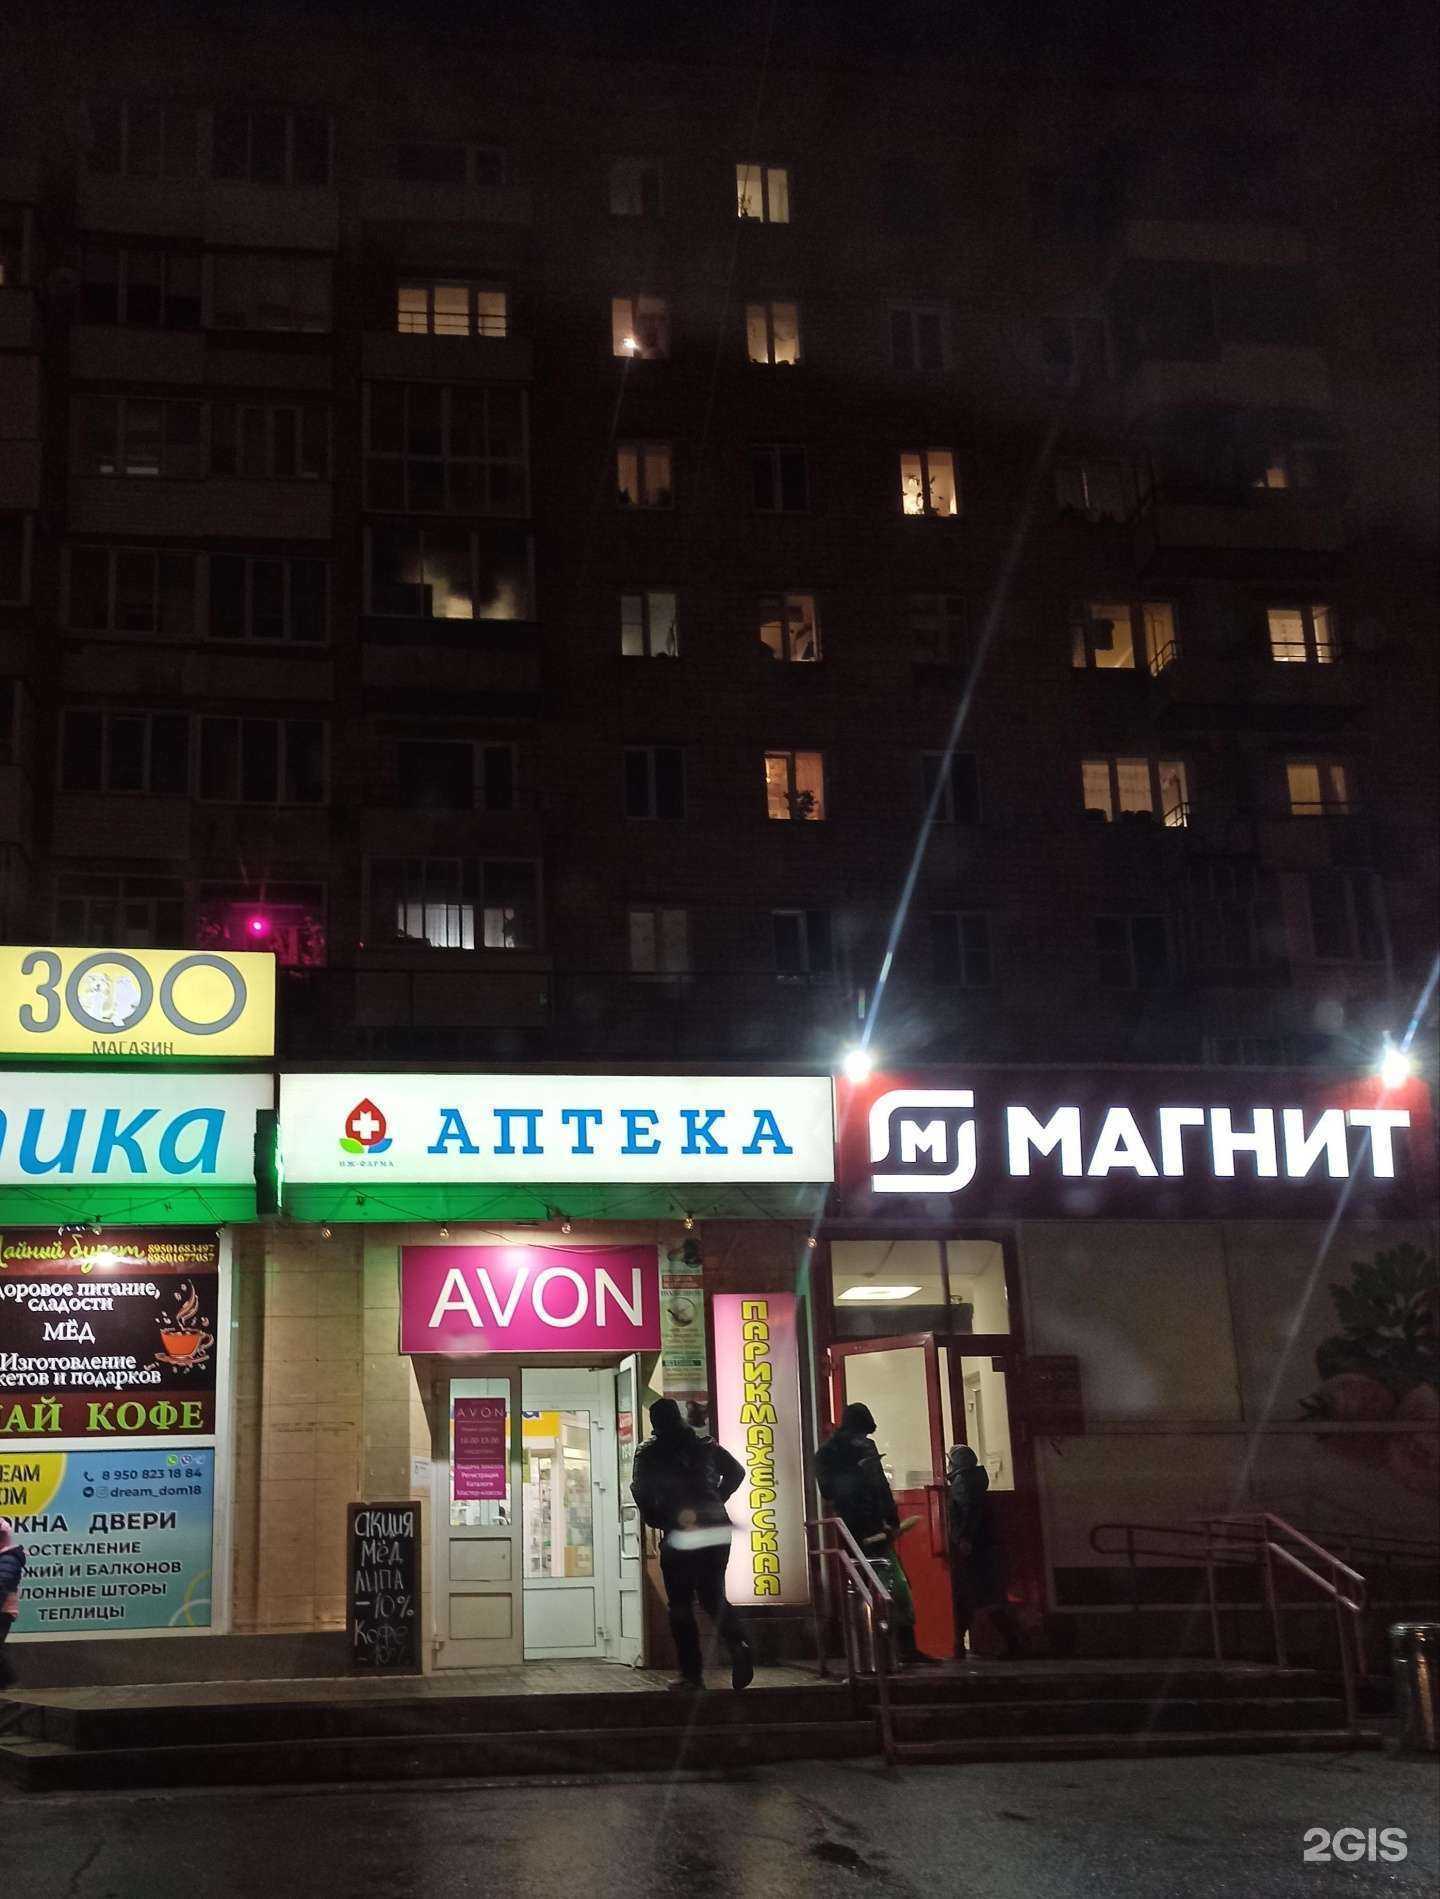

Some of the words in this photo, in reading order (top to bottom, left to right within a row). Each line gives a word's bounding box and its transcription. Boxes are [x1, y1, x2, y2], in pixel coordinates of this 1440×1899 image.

[19, 950, 247, 1036] ЗОО
[92, 1040, 174, 1056] МАГАЗИН
[0, 1107, 226, 1175] ика
[427, 1108, 793, 1155] АПТЕКА
[1007, 1106, 1410, 1178] МАГНИТ
[77, 1282, 160, 1300] питание,
[428, 1268, 642, 1328] AVON
[43, 1319, 96, 1344] МЁД
[0, 1353, 137, 1372] Изготовление
[53, 1371, 66, 1384] и
[74, 1370, 162, 1391] подарков
[0, 1395, 63, 1432] АЙ
[86, 1400, 204, 1431] КОФЕ
[456, 1407, 504, 1418] AVON
[740, 1300, 780, 1596] ПАРИКМАХЕРСКАЯ
[102, 1471, 111, 1481] 8
[114, 1469, 138, 1480] 950
[142, 1469, 164, 1480] 823
[169, 1468, 181, 1479] 18
[185, 1467, 203, 1478] 84
[110, 1486, 202, 1498] dream_dom18
[89, 1512, 176, 1534] ДВЕРИ
[29, 1541, 141, 1556] ОСТЕКЛЕНИЕ
[70, 1565, 81, 1577] И
[86, 1561, 181, 1576] БАЛКОНОВ
[101, 1583, 167, 1597] ШТОРЫ
[38, 1606, 125, 1621] ТЕПЛИЦЫ
